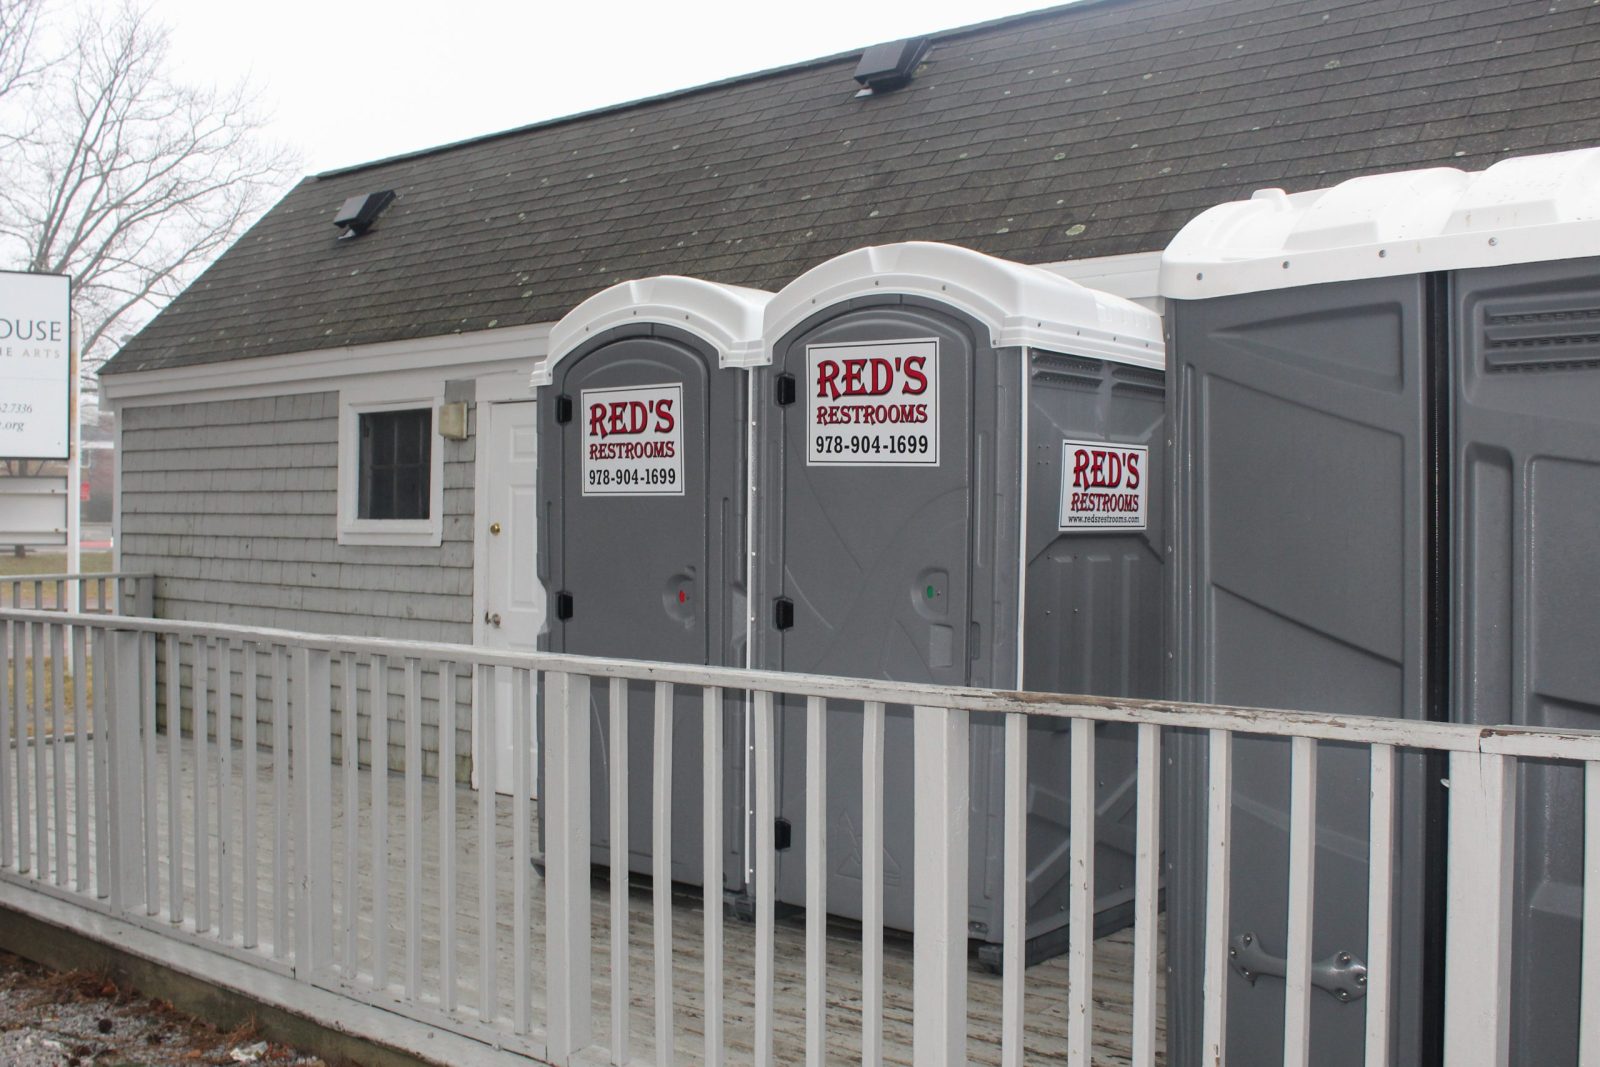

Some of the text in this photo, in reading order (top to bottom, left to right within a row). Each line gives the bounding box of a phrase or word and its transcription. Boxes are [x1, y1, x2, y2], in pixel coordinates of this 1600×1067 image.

[0, 347, 61, 359] E ARTS
[817, 356, 928, 402] RED'S
[0, 402, 33, 414] 2.7336
[816, 404, 928, 426] RESTROOMS
[589, 399, 675, 440] RED'S
[589, 441, 675, 461] RESTROOMS
[816, 435, 928, 454] 978-904-1699
[589, 468, 676, 486] 978-904-1699
[1072, 449, 1140, 492] RED'S
[1070, 492, 1140, 513] RESTROOMS
[1068, 513, 1140, 524] www.redsrestrooms.com
